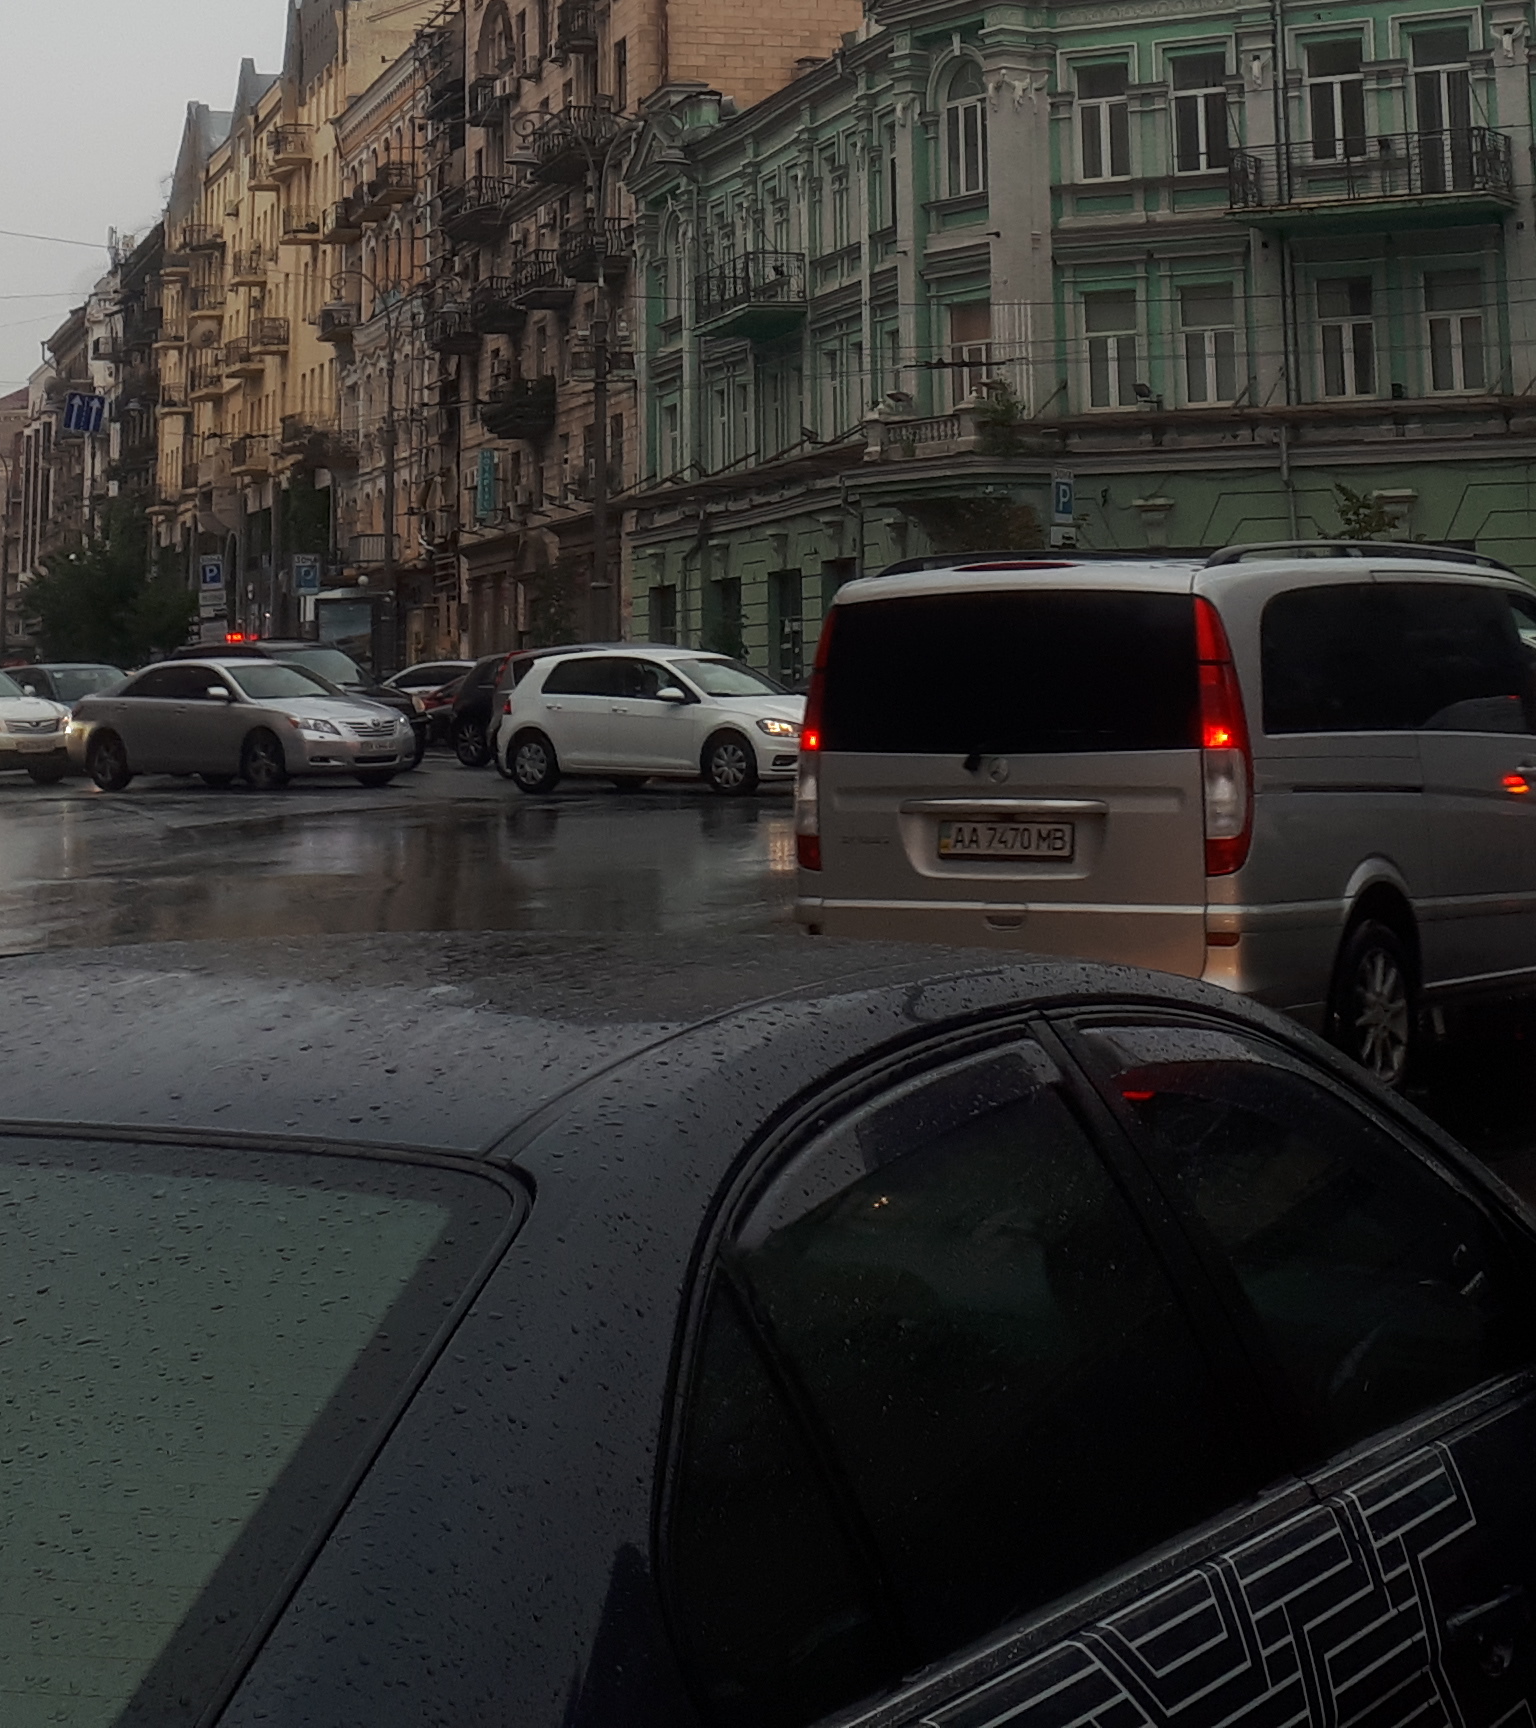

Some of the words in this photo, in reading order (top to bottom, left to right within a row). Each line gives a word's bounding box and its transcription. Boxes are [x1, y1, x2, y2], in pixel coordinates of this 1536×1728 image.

[952, 826, 980, 850] AA
[987, 826, 1032, 850] 7470
[1035, 826, 1065, 851] MB
